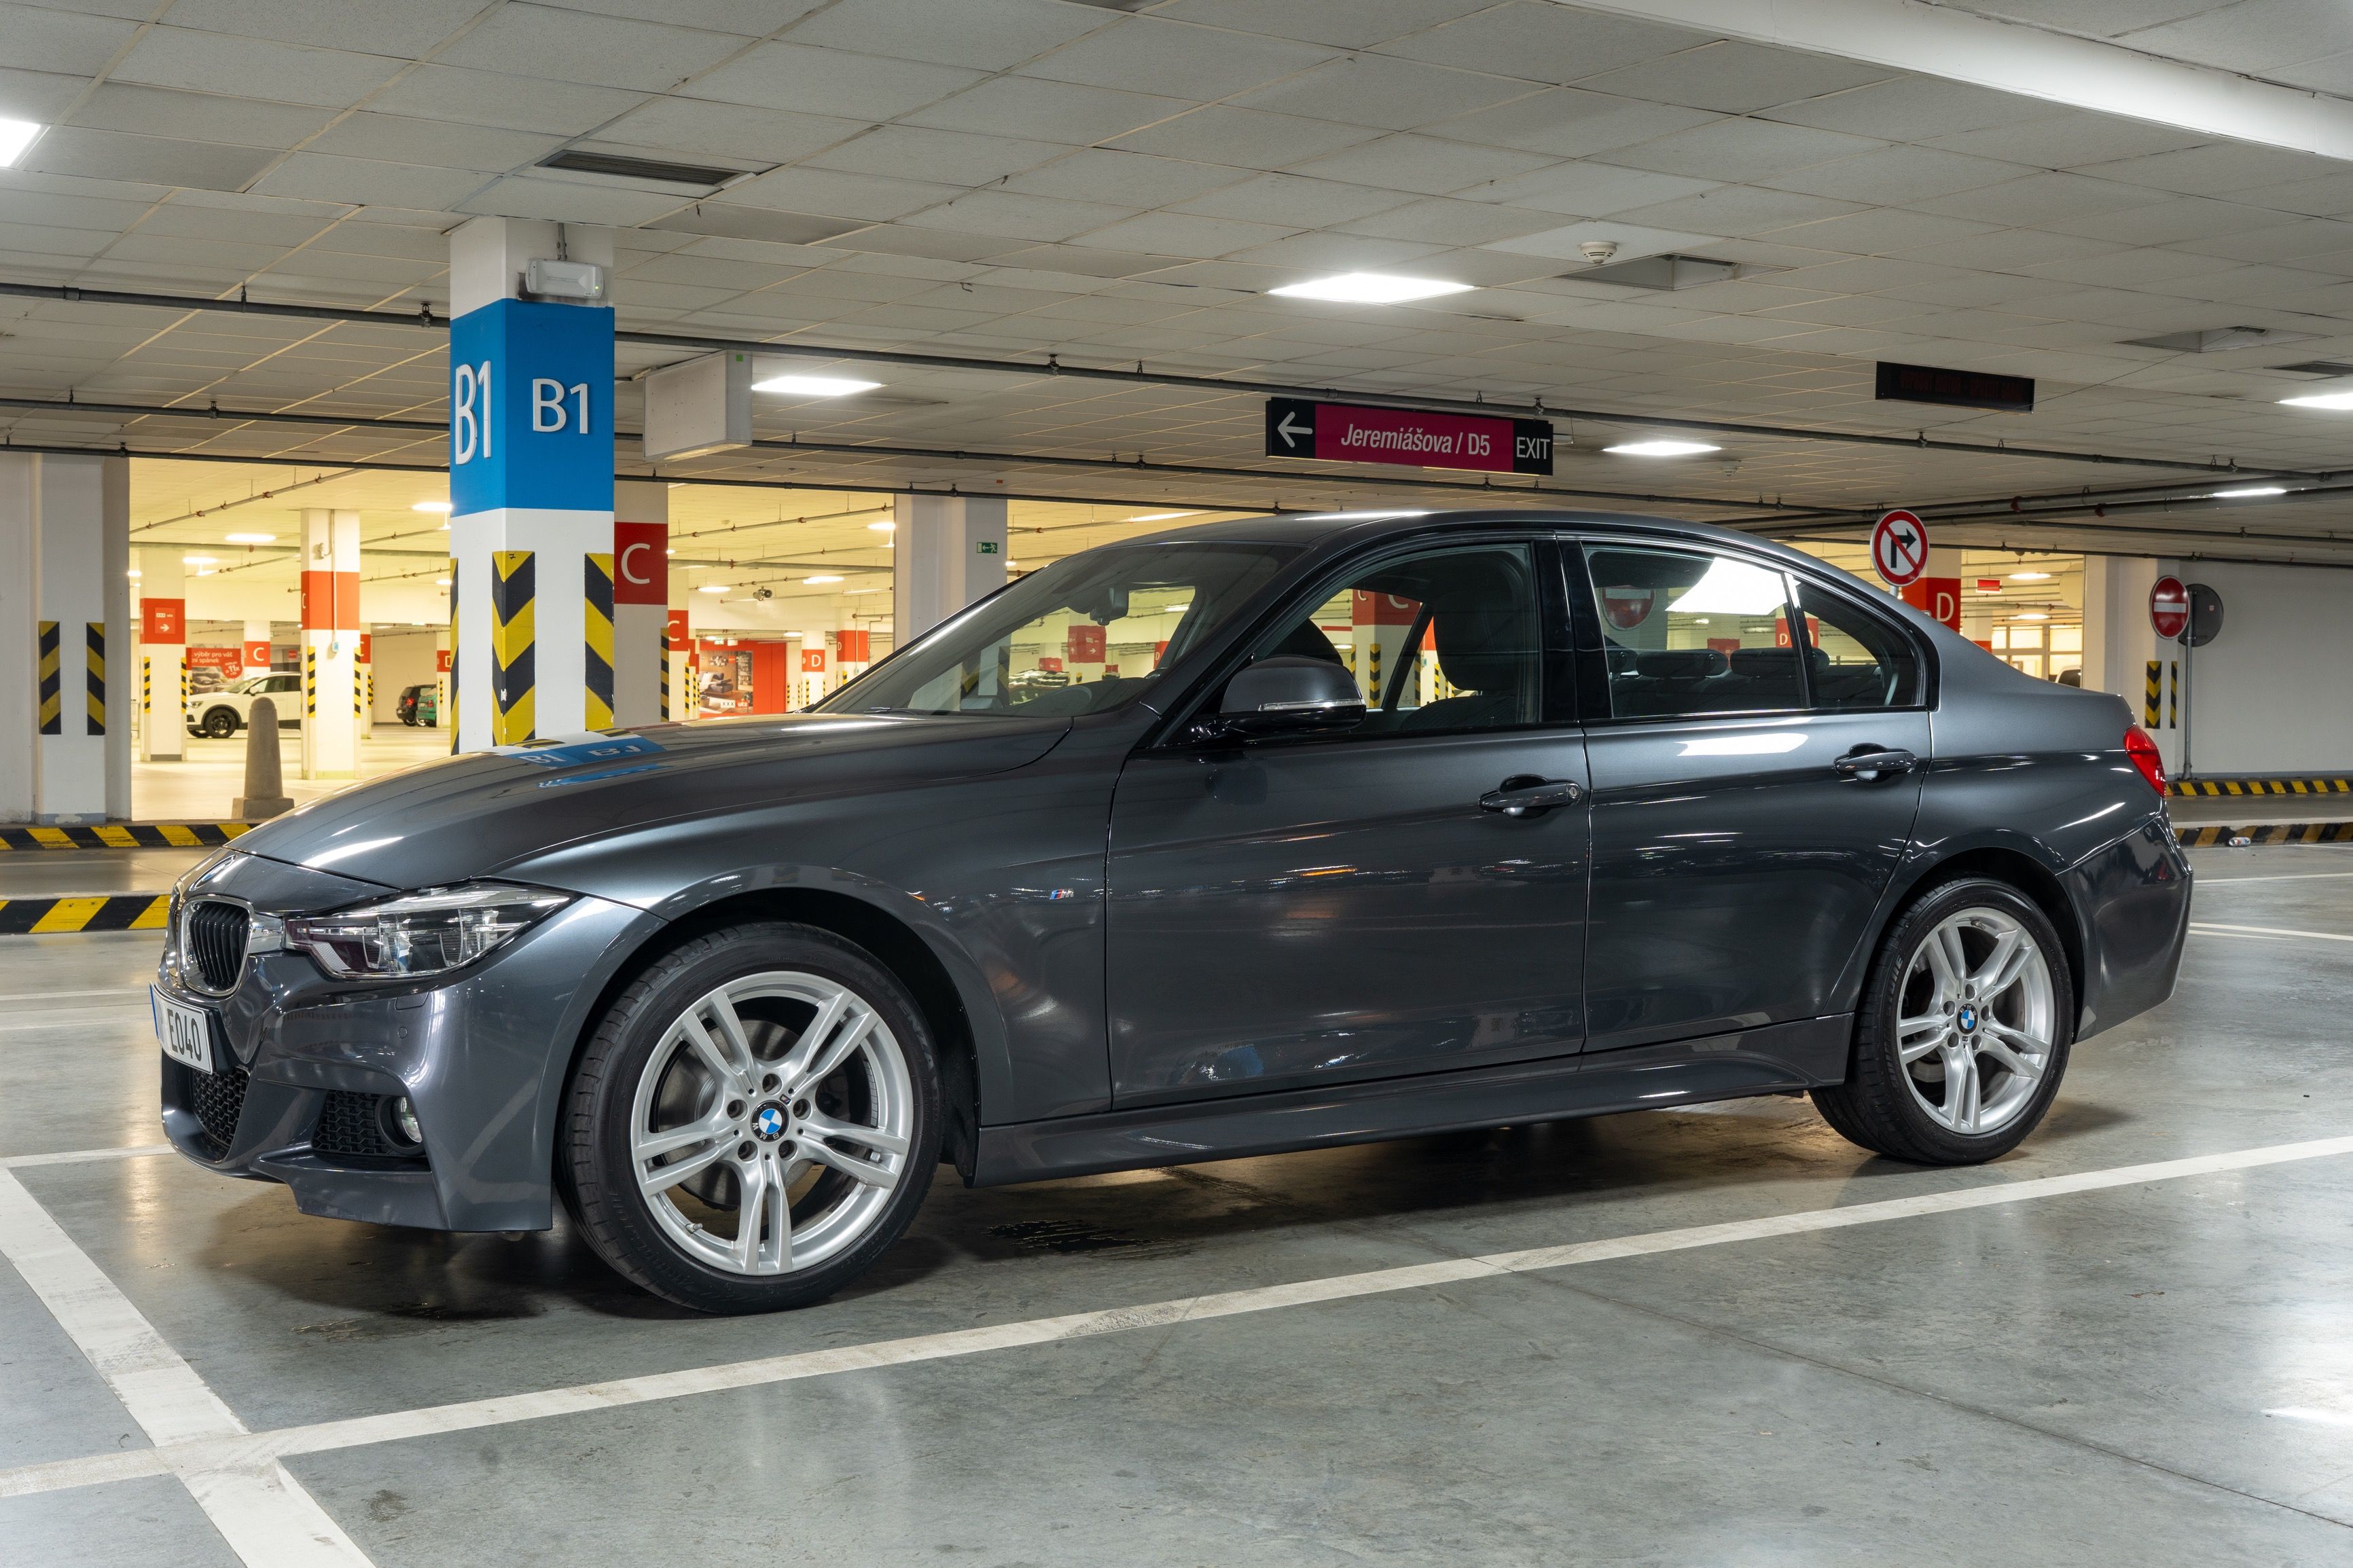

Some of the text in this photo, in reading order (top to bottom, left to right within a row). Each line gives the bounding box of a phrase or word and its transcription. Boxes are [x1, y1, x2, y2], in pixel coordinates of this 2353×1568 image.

[455, 360, 490, 465] B1
[533, 378, 588, 434] B1
[1341, 423, 1452, 454] Jeremiášova
[1468, 433, 1490, 456] D5
[1516, 437, 1550, 459] EXIT
[621, 543, 650, 584] C
[1937, 592, 1954, 622] D
[668, 620, 680, 642] C
[1779, 634, 1788, 645] D
[253, 647, 264, 661] C
[811, 654, 821, 667] D
[752, 1123, 780, 1140] BMW
